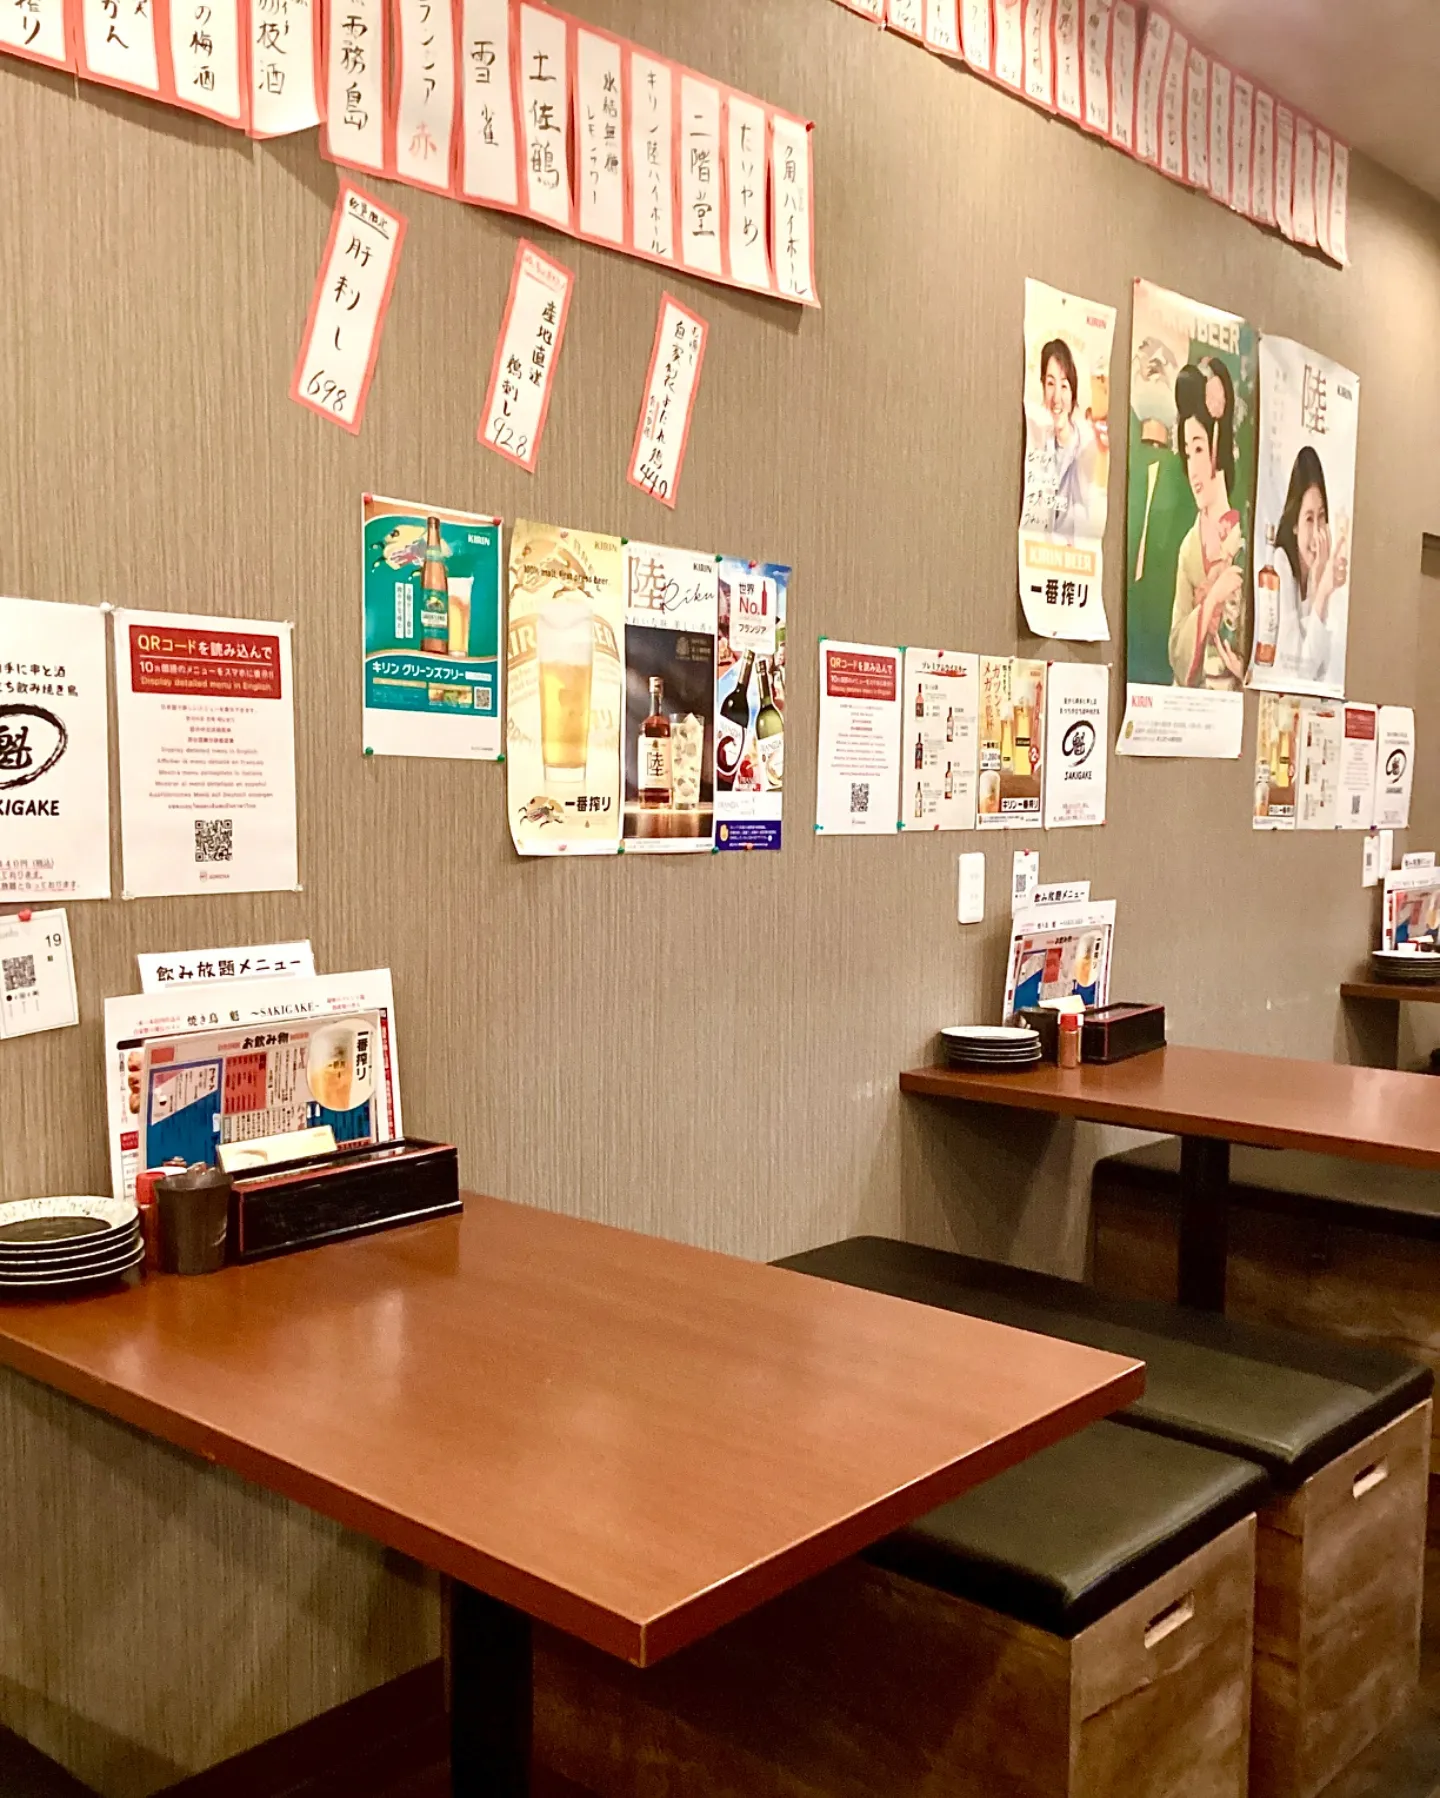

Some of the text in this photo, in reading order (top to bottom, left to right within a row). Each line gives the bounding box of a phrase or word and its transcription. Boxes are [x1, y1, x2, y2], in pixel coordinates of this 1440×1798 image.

[340, 0, 369, 131] 霧島
[529, 51, 562, 189] 土佐鶴
[690, 114, 716, 237] 二階堂
[334, 235, 374, 351] 肝刺し
[1197, 318, 1240, 355] BEER
[306, 370, 347, 413] 698
[493, 417, 528, 458] 928
[467, 534, 490, 546] KIRIN
[627, 556, 667, 614] 陸
[739, 583, 755, 595] 世界
[1031, 579, 1088, 608] 一番搾り
[738, 623, 767, 635] フランジア
[137, 634, 273, 660] QRコードを読み込んで
[0, 662, 66, 677] 手に串と酒
[372, 661, 400, 675] キリン
[1064, 770, 1092, 781] SAKIGAKE
[565, 796, 611, 812] 一番搾り
[45, 933, 62, 947] 19
[156, 958, 302, 982] 飲み放題メニュー
[243, 1032, 290, 1049] お飲み物
[356, 1030, 369, 1081] 一番搾り
